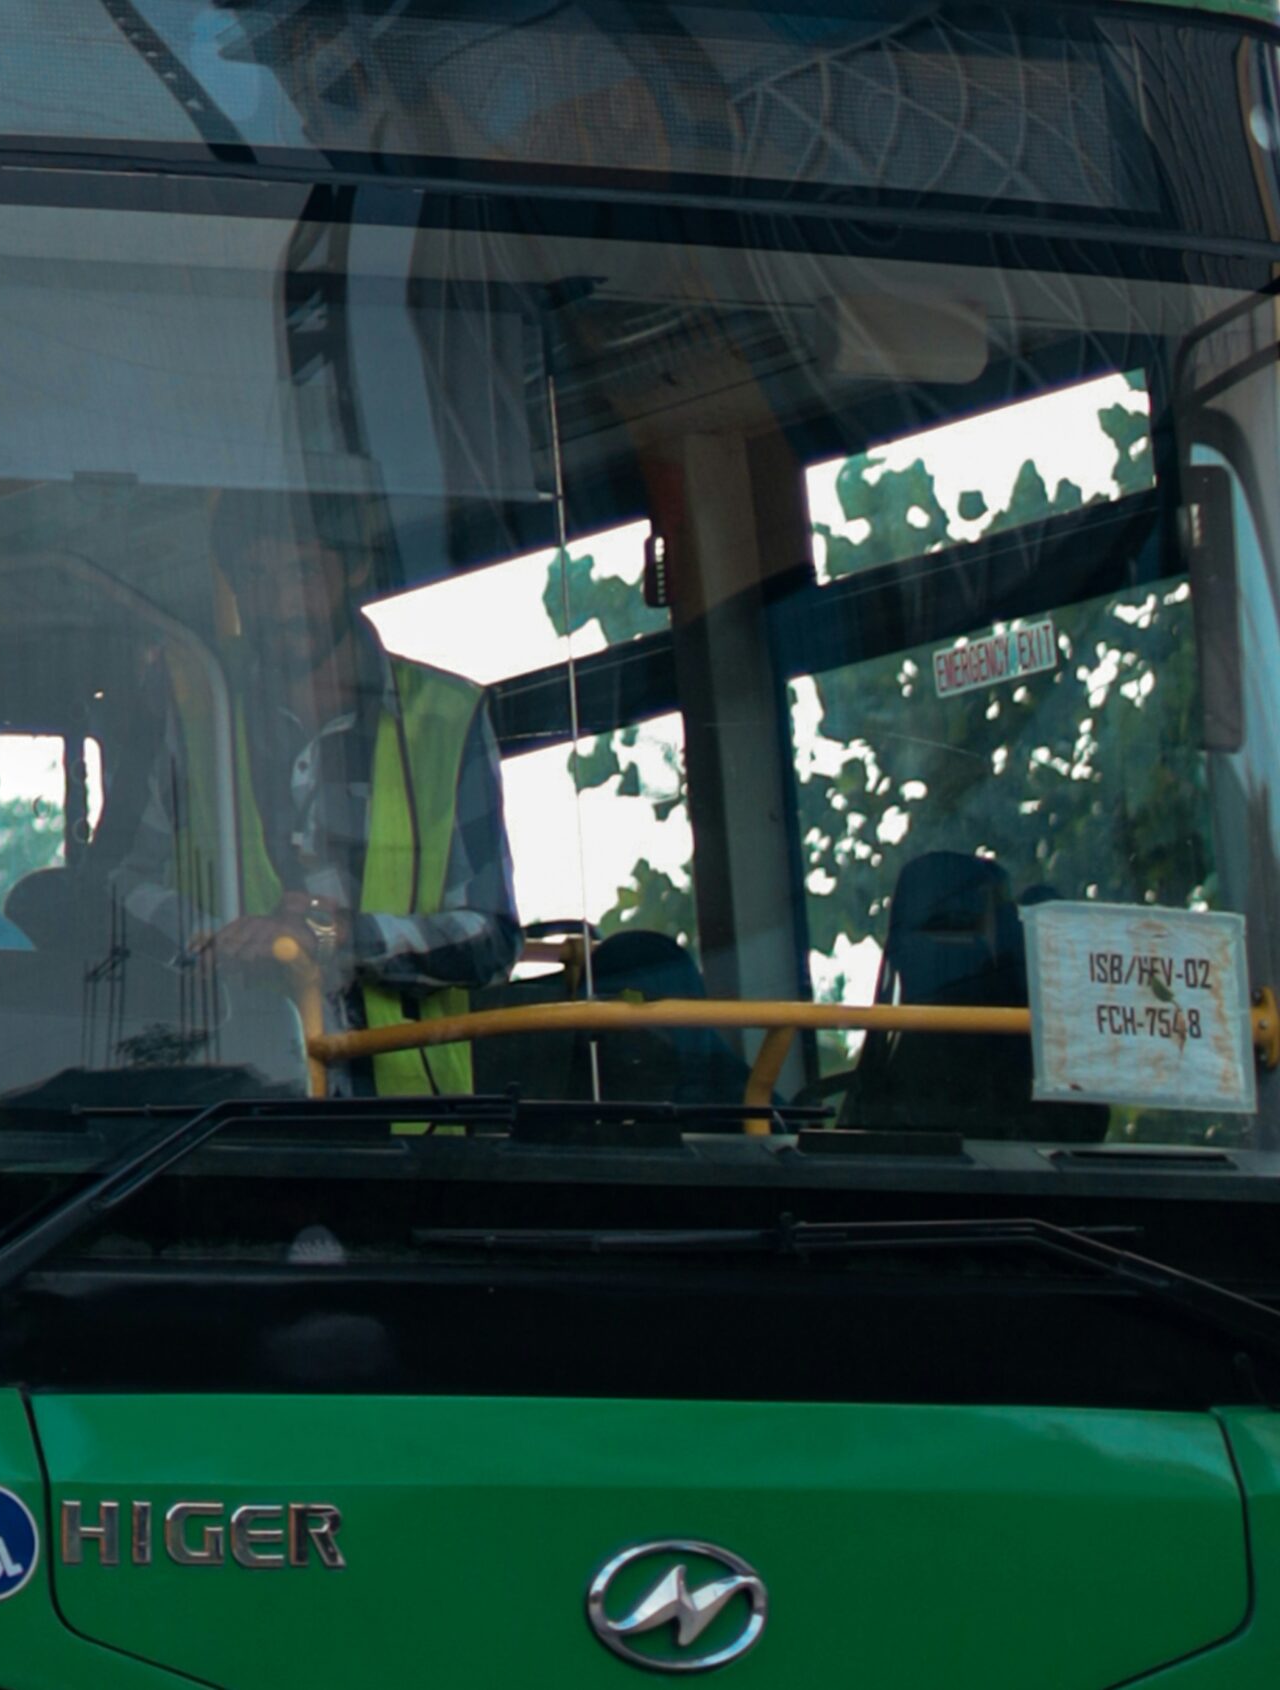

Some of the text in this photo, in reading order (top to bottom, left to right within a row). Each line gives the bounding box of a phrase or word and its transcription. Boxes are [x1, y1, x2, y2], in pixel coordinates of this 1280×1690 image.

[935, 623, 1053, 693] EMERGENCY EXIT
[61, 1499, 347, 1568] HIGER
